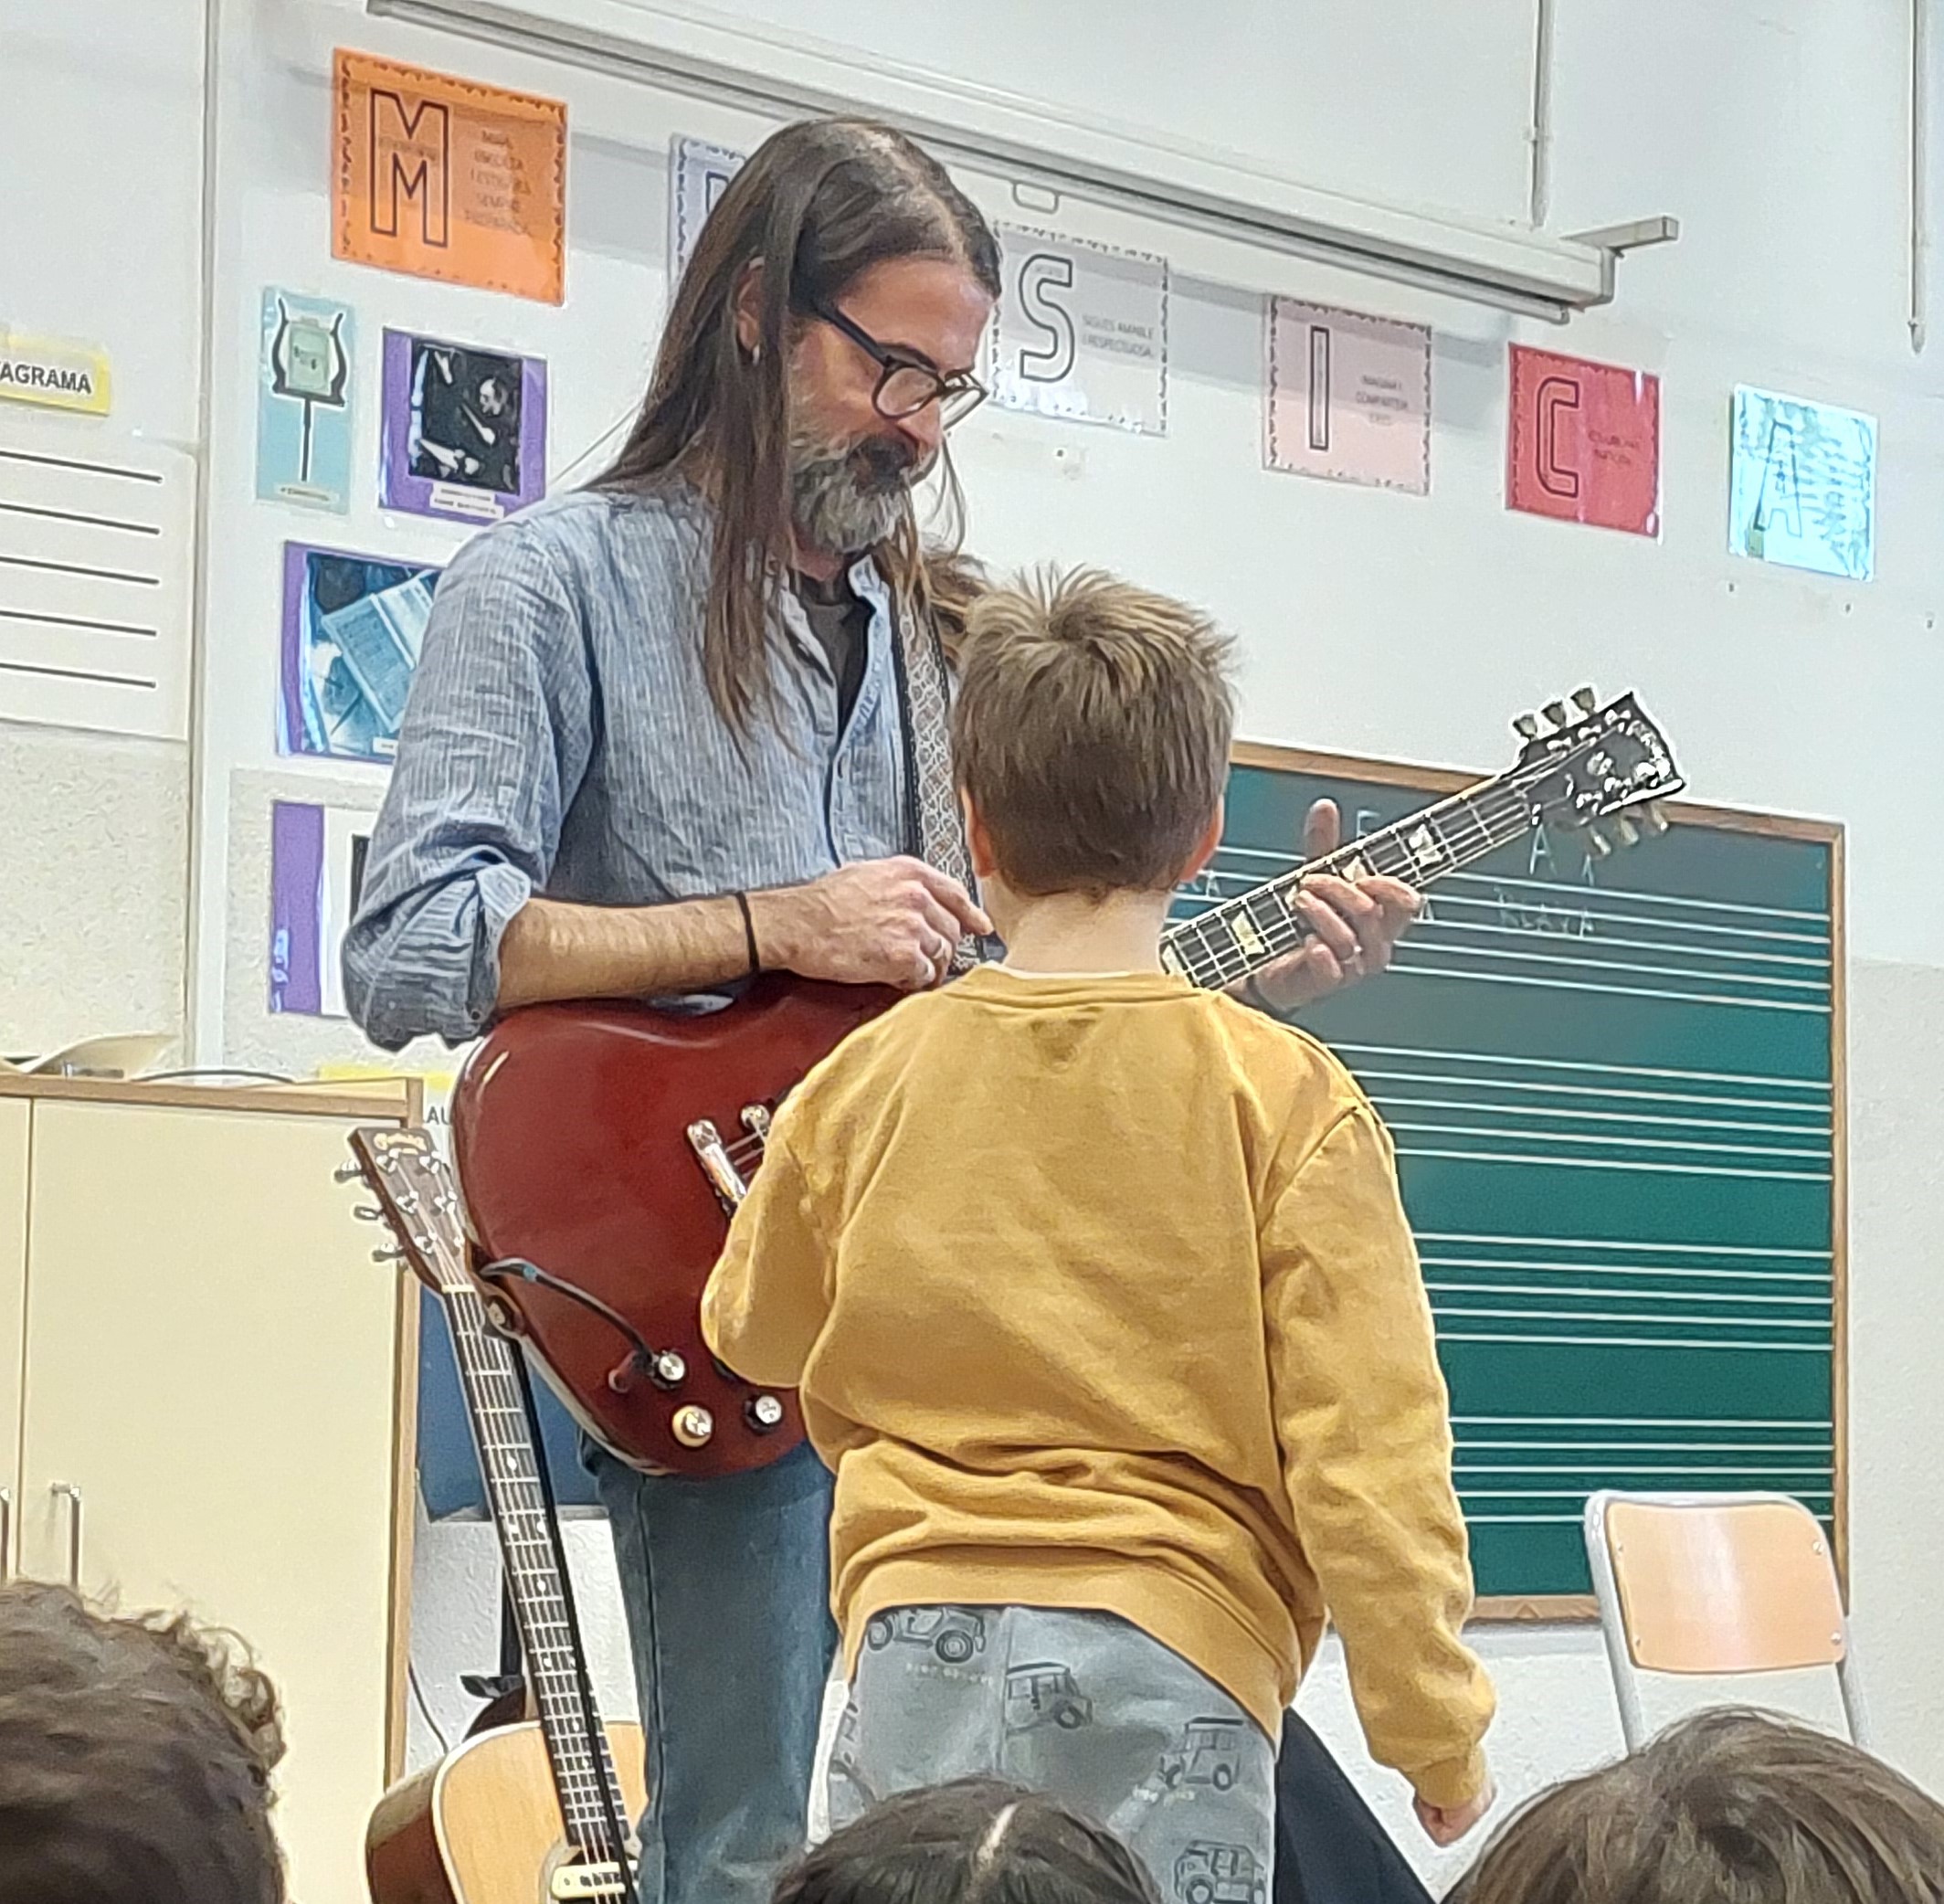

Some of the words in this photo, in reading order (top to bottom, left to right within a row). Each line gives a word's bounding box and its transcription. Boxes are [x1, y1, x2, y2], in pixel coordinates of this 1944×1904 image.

[370, 88, 449, 249] M
[0, 360, 91, 395] AGRAMA
[1019, 253, 1075, 384] S
[1310, 324, 1329, 451] I
[1537, 376, 1579, 498] C
